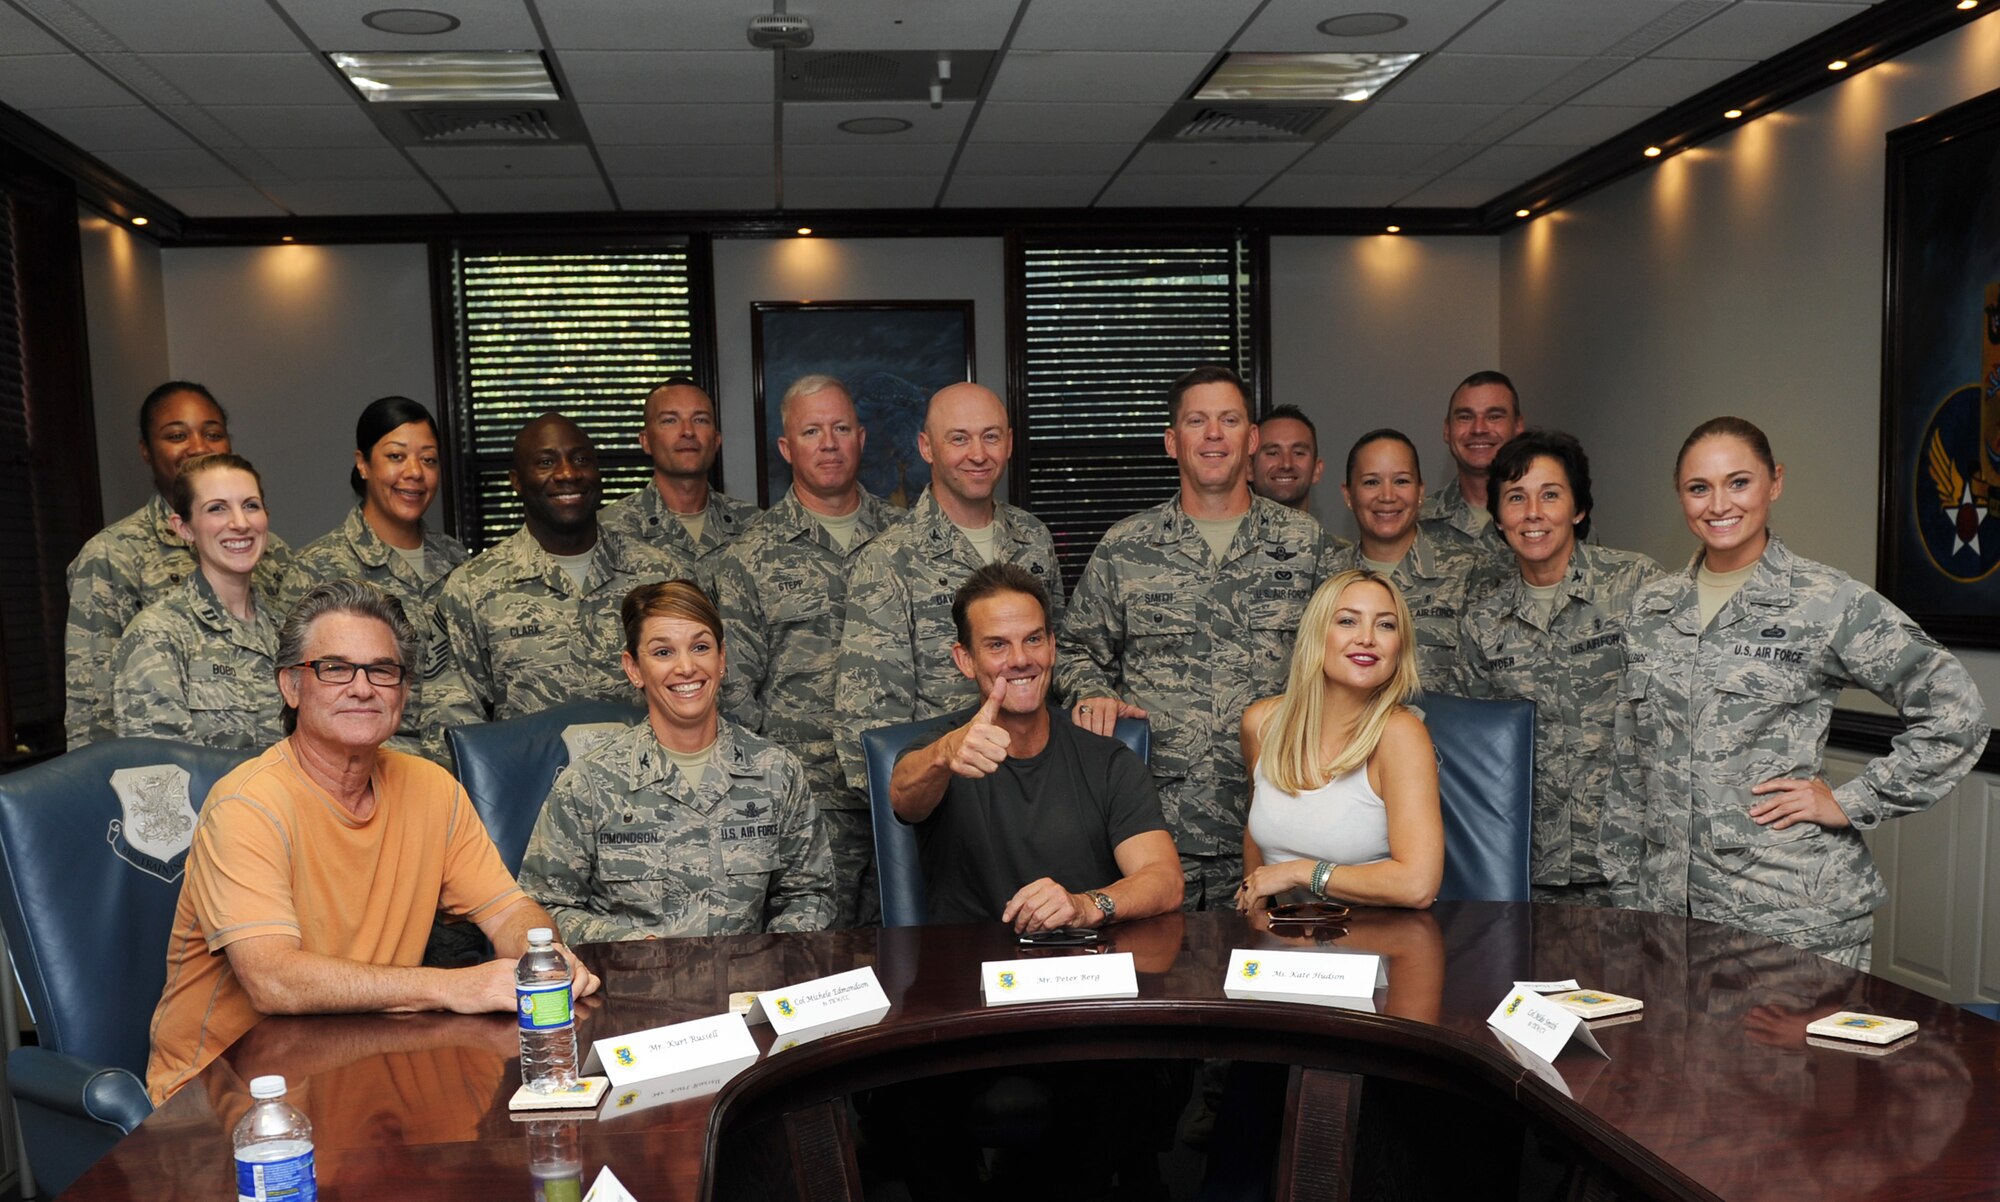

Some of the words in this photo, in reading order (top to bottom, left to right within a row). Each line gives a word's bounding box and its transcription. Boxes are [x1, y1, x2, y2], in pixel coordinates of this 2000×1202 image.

[778, 580, 803, 591] STEPP
[510, 624, 541, 638] CLARK
[1586, 638, 1601, 651] AIR
[1734, 645, 1752, 657] U.S.
[1754, 646, 1772, 659] AIR
[1773, 648, 1804, 664] FORCE
[600, 831, 658, 844] EDMONDSON
[720, 828, 738, 840] U.S.
[740, 826, 756, 838] AIR
[757, 824, 779, 837] FORCE
[689, 1029, 719, 1043] Russell
